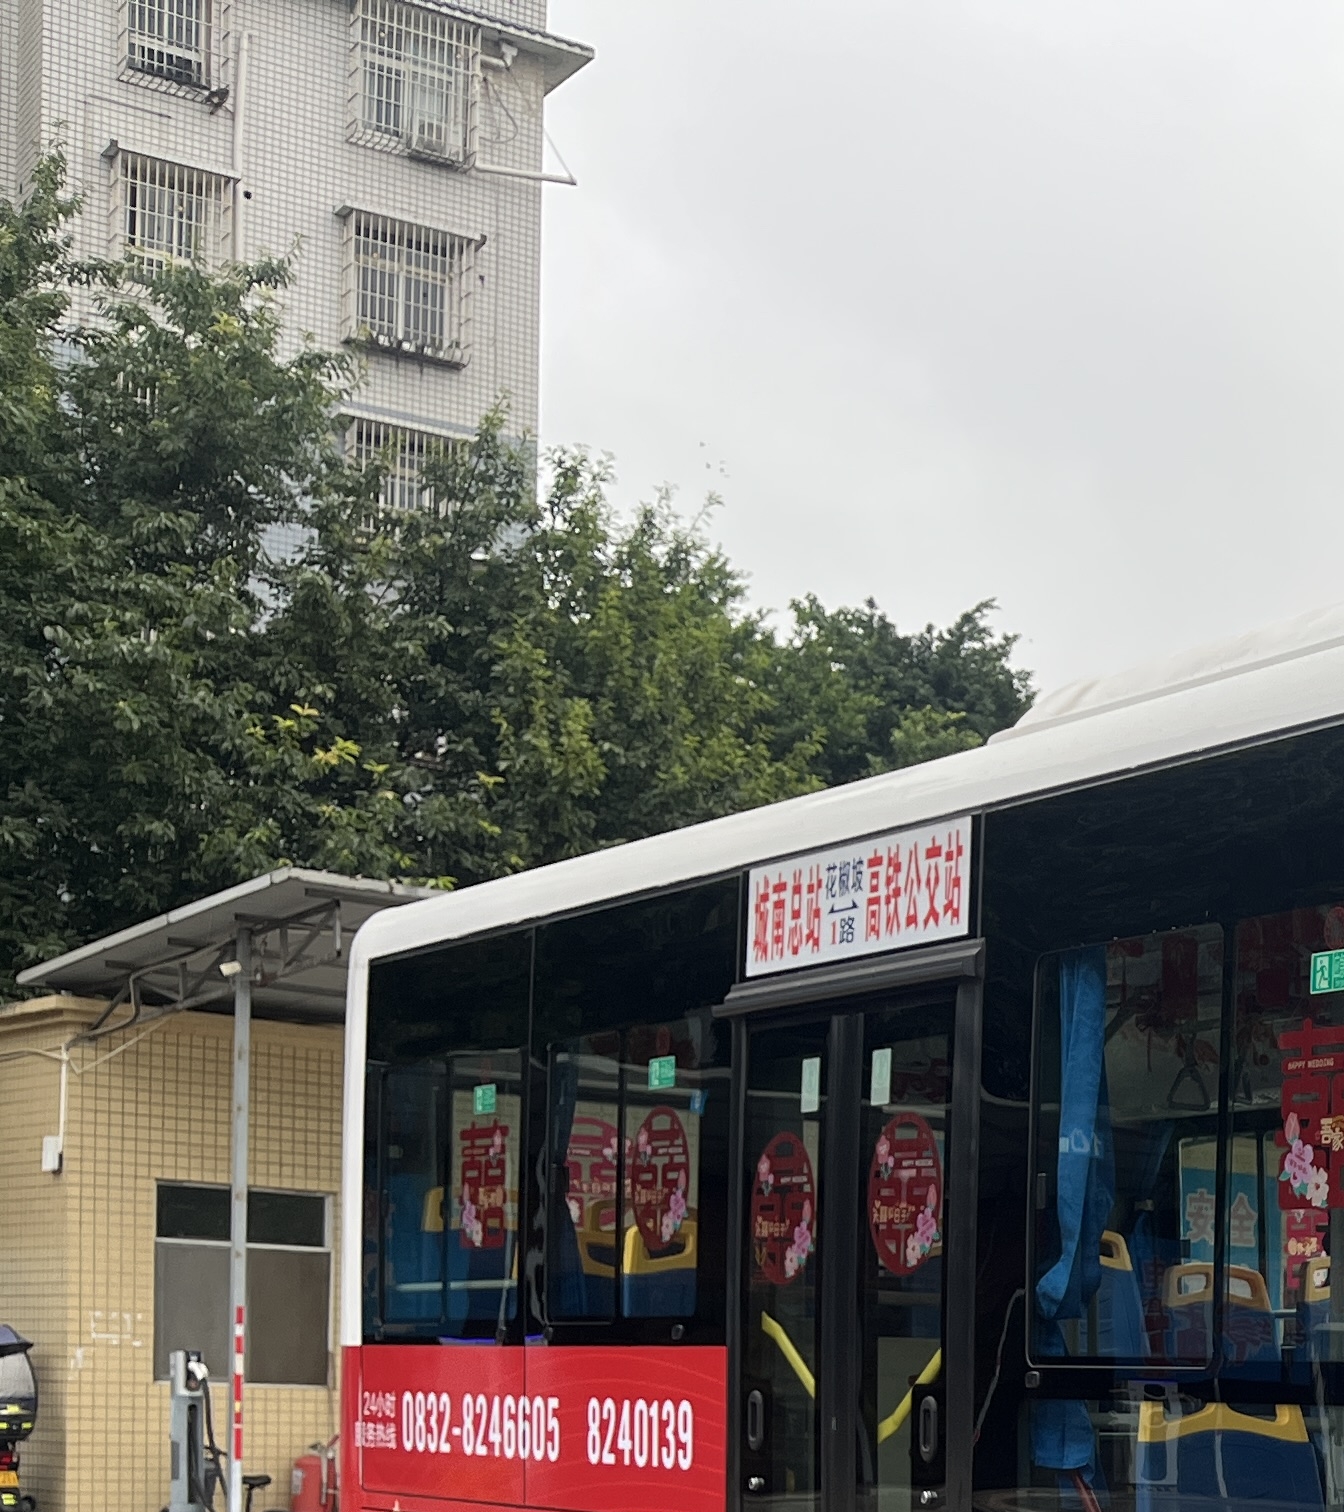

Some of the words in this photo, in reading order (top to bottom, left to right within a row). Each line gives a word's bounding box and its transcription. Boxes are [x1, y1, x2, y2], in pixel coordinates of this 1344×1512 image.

[753, 863, 822, 962] 城南总站
[825, 856, 864, 900] 花椒坡
[865, 829, 963, 942] 高铁公交站
[830, 916, 855, 946] 1路
[402, 1390, 560, 1462] 0832-8246605
[586, 1397, 694, 1471] 8240139
